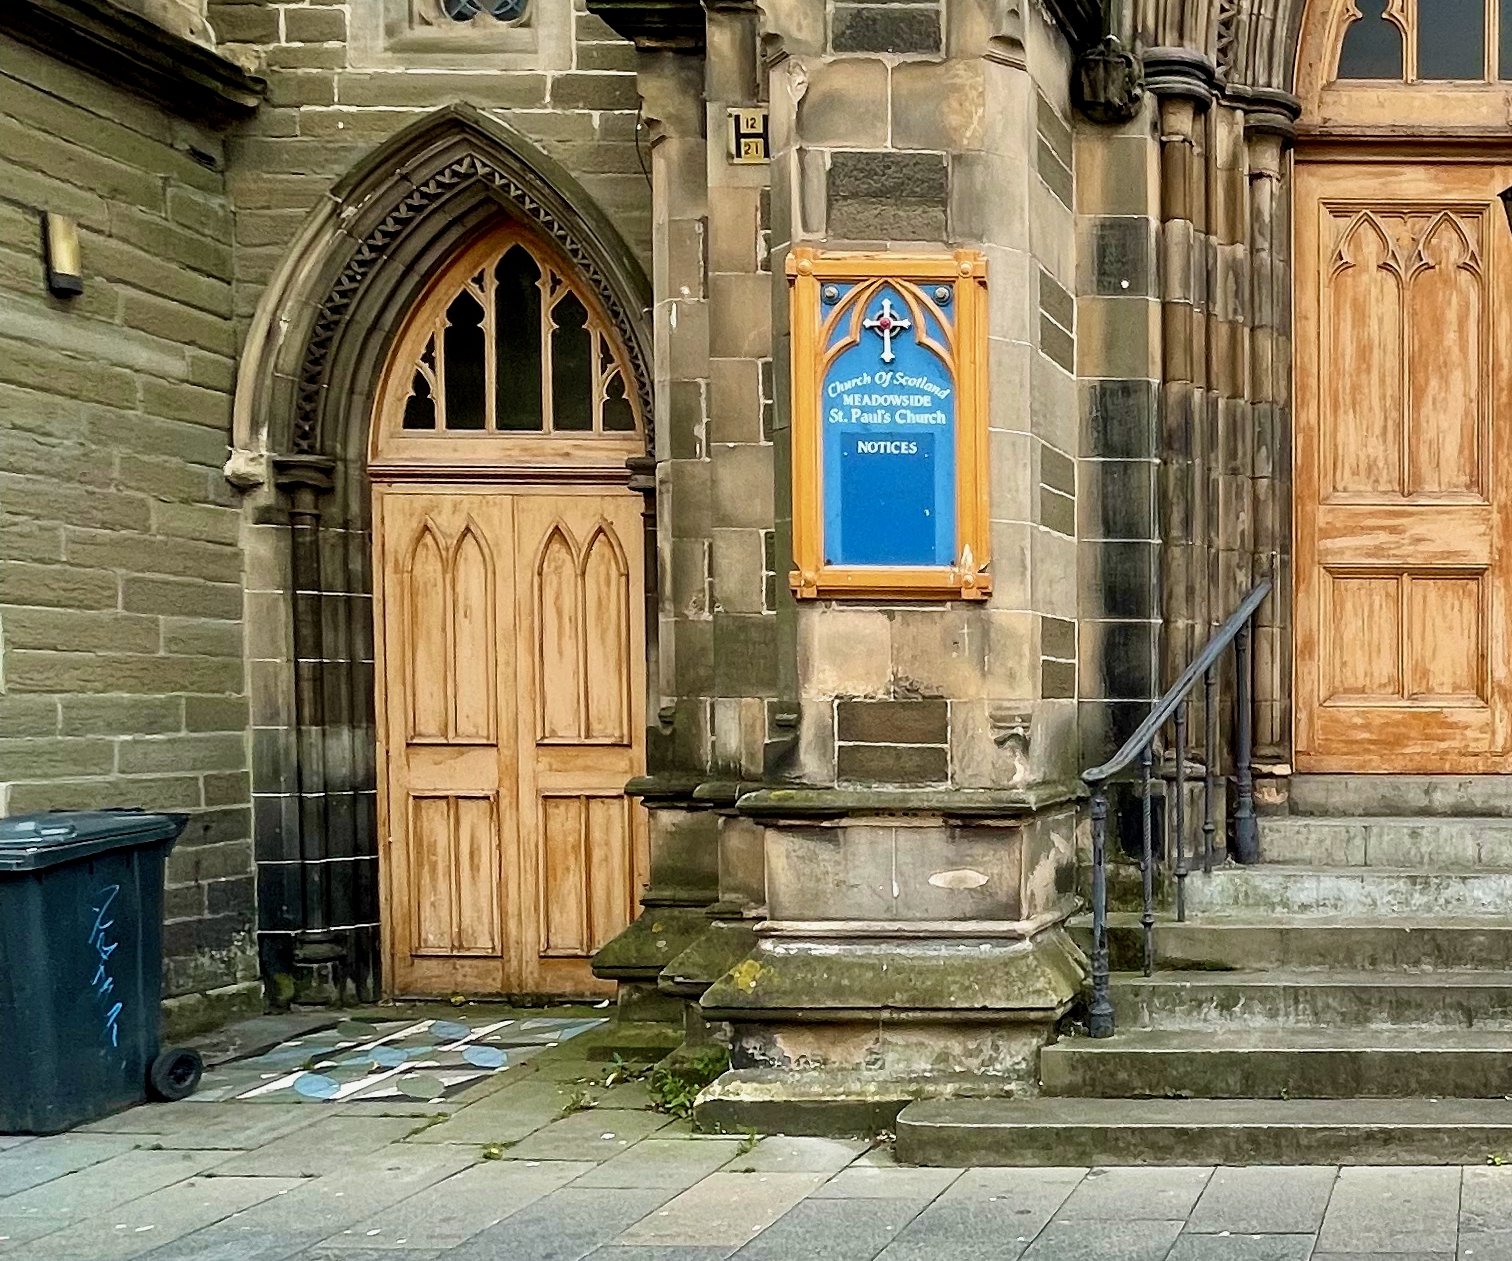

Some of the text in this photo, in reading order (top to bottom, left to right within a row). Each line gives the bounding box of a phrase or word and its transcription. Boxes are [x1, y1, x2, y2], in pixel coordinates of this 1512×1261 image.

[746, 118, 756, 128] 12
[828, 371, 951, 400] Church Of Scotland
[843, 394, 931, 406] MEADOWSIDE
[828, 408, 947, 424] St. Paul's Church
[857, 440, 918, 454] NOTICES
